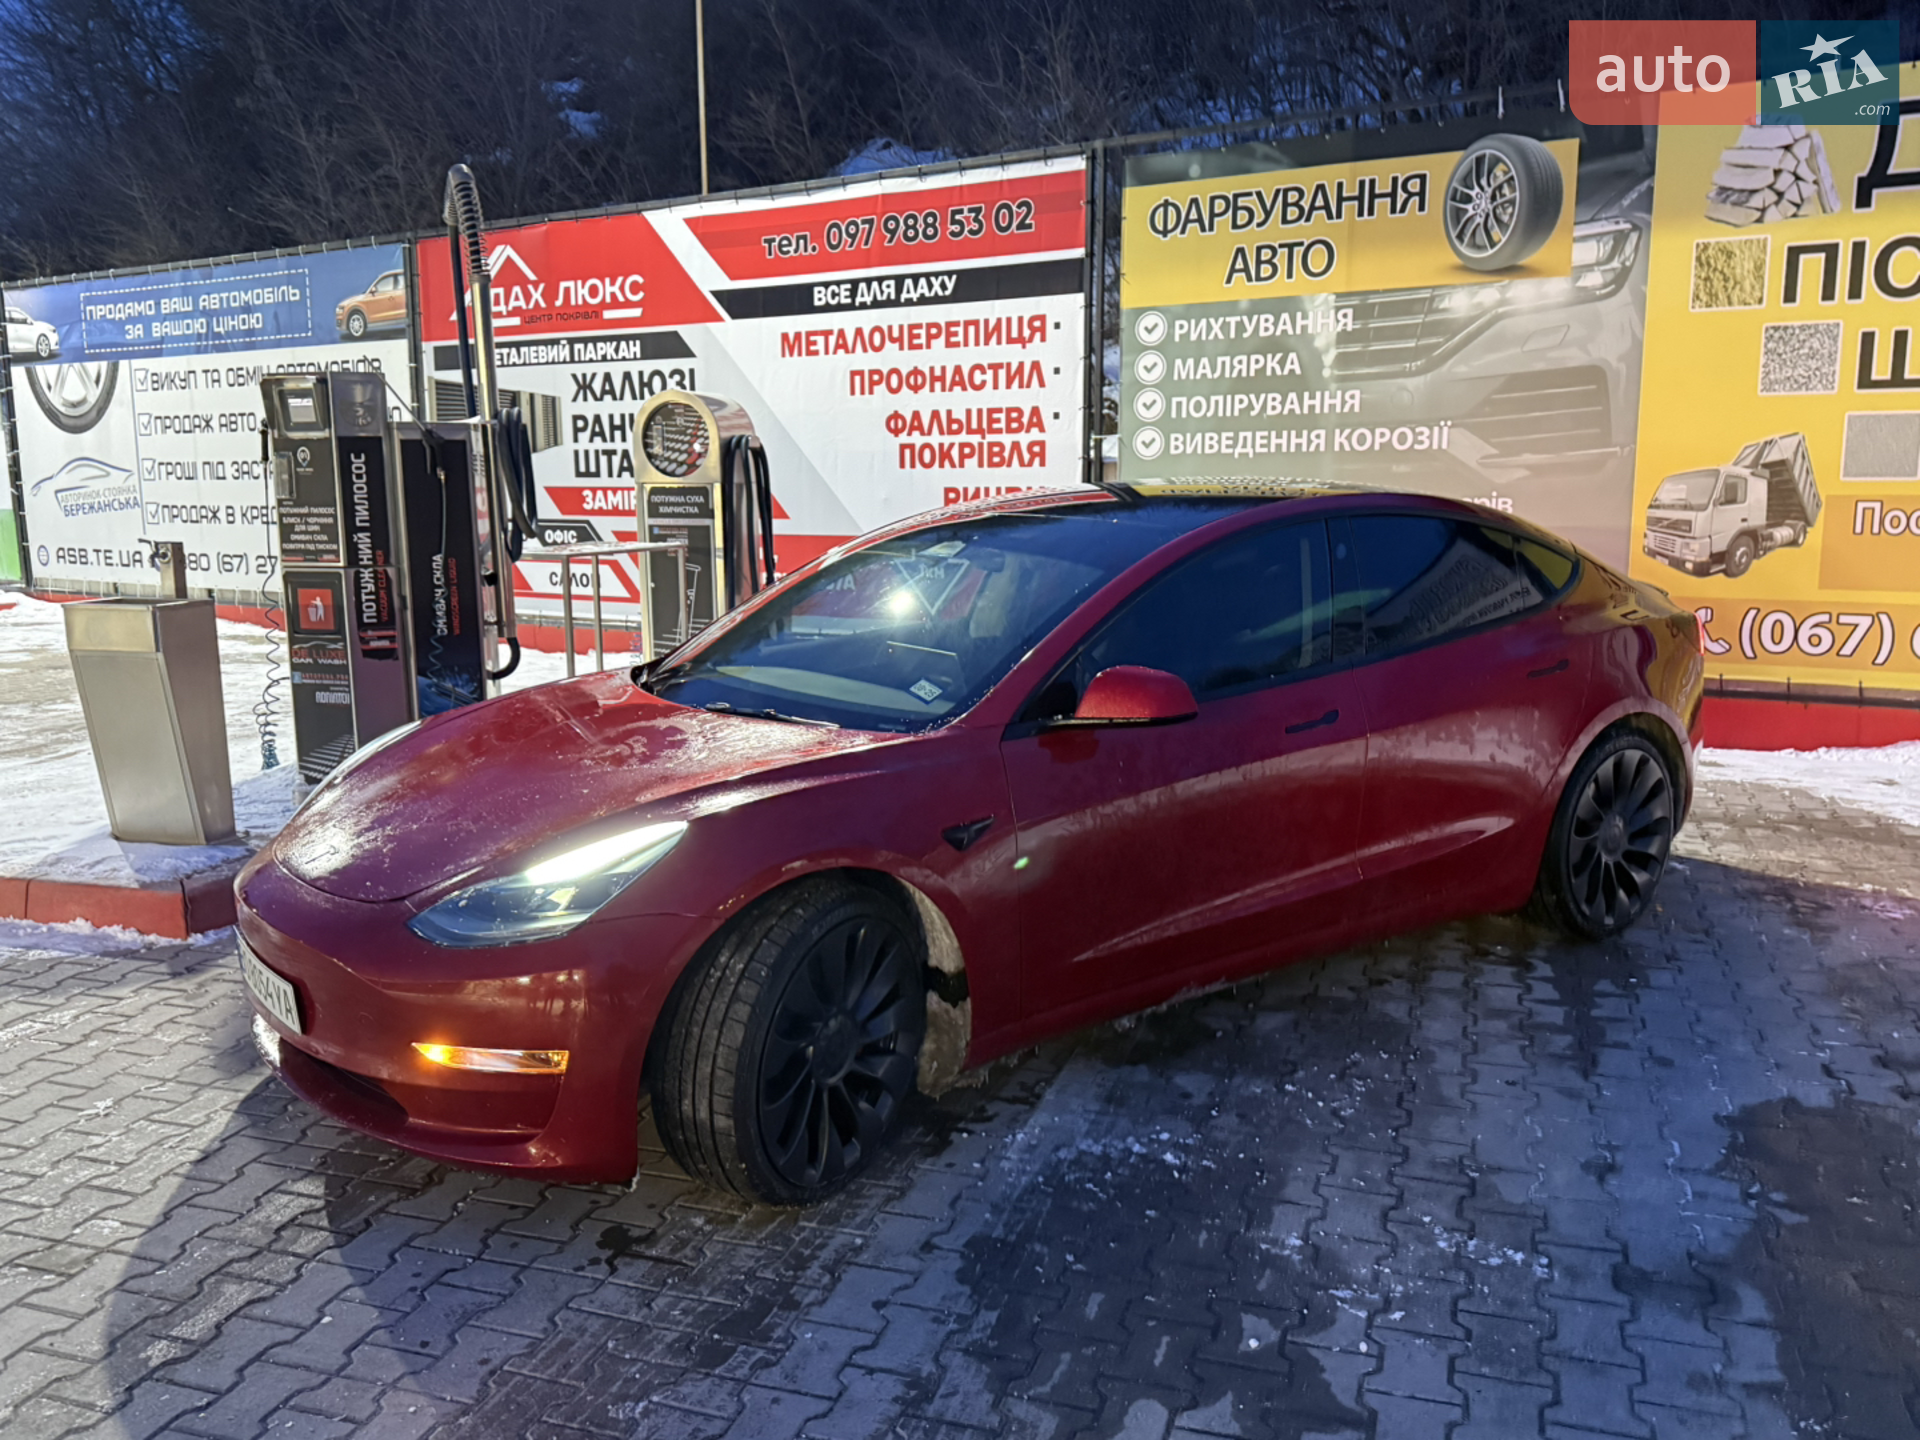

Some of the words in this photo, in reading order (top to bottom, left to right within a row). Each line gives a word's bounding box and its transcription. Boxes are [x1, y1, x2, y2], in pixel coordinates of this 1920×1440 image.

[1149, 171, 1428, 240] ФАРБУВАННЯ
[762, 233, 818, 258] тел.
[824, 216, 877, 252] 097
[881, 209, 940, 246] 988
[947, 204, 985, 240] 53
[993, 198, 1035, 235] 02
[1224, 238, 1337, 287] АВТО
[86, 300, 155, 320] ПРОДАМО
[161, 296, 193, 315] ВАШ
[199, 285, 300, 310] АВТОМОБІЛЬ
[490, 283, 547, 315] ДАХ
[554, 274, 645, 307] ЛЮКС
[813, 284, 851, 306] ВСЕ
[855, 279, 896, 306] ДЛЯ
[900, 274, 956, 303] ДАХУ
[125, 324, 143, 340] ЗА
[152, 318, 206, 337] ВАШОЮ
[213, 312, 262, 334] ЦІНОЮ
[524, 313, 553, 325] ЦЕНТР
[556, 311, 599, 322] ПОКРІВЛІ
[1174, 308, 1353, 342] РИХТУВАННЯ
[780, 314, 1046, 358] МЕТАЛОЧЕРЕПИЦЯ
[495, 340, 568, 366] ЕТАЛЕВИЙ
[574, 340, 641, 362] ПАРКАН
[1173, 352, 1301, 381] МАЛЯРКА
[151, 369, 196, 391] ВИКУП
[202, 369, 221, 388] ТА
[571, 368, 695, 402] ЖАЛЮЗІ
[849, 360, 1046, 396] ПРОФНАСТИЛ
[1171, 389, 1360, 418] ПОЛІРУВАННЯ
[154, 414, 214, 434] ПРОДАЖ
[885, 406, 1046, 440] ФАЛЬЦЕВА
[1169, 428, 1326, 458] ВИВЕДЕННЯ
[1333, 420, 1452, 452] КОРОЗІЇ
[899, 440, 1046, 469] ПОКРІВЛЯ
[158, 461, 197, 480] ГРОШІ
[203, 461, 227, 480] ПІД
[351, 453, 371, 527] ПИЛОСОС
[650, 495, 685, 504] ПОТУЖНА
[686, 495, 704, 504] СУХА
[63, 496, 140, 517] БЕРЕЖАНСЬКА
[162, 505, 220, 524] ПРОДАЖ
[226, 505, 236, 524] В
[544, 529, 577, 544] ОФІС
[56, 547, 143, 568] ASB.TE.UA
[217, 553, 248, 574] (67)
[1739, 608, 1895, 666] (067)
[312, 650, 345, 659] LUXE
